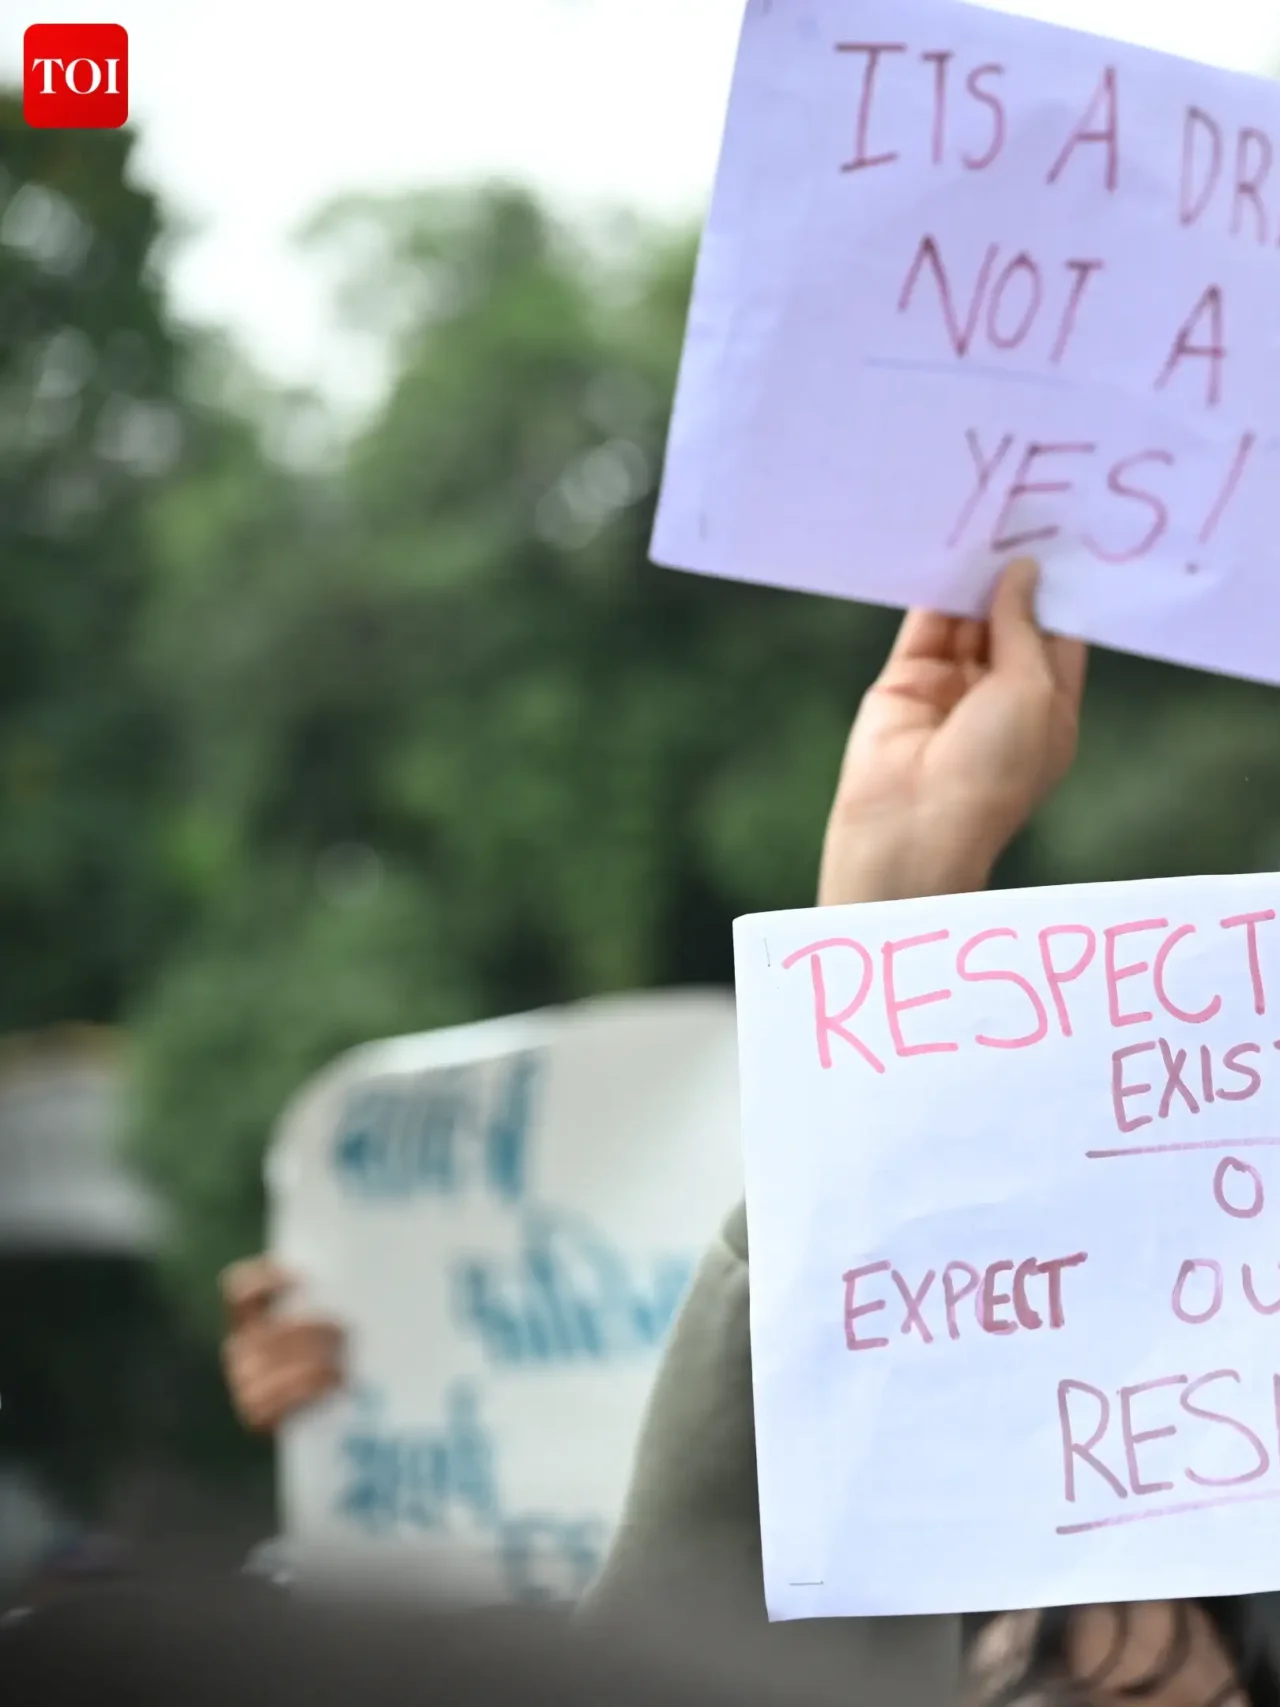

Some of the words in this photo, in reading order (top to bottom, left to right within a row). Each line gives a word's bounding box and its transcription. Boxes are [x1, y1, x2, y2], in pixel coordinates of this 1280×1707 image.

[834, 42, 1006, 172] ITS
[1046, 65, 1118, 192] A
[897, 233, 1104, 365] NOT
[1154, 283, 1229, 408] A
[945, 427, 1257, 575] YES!
[781, 908, 1276, 1075] RESPECT
[841, 1250, 1089, 1352] EXPECT
